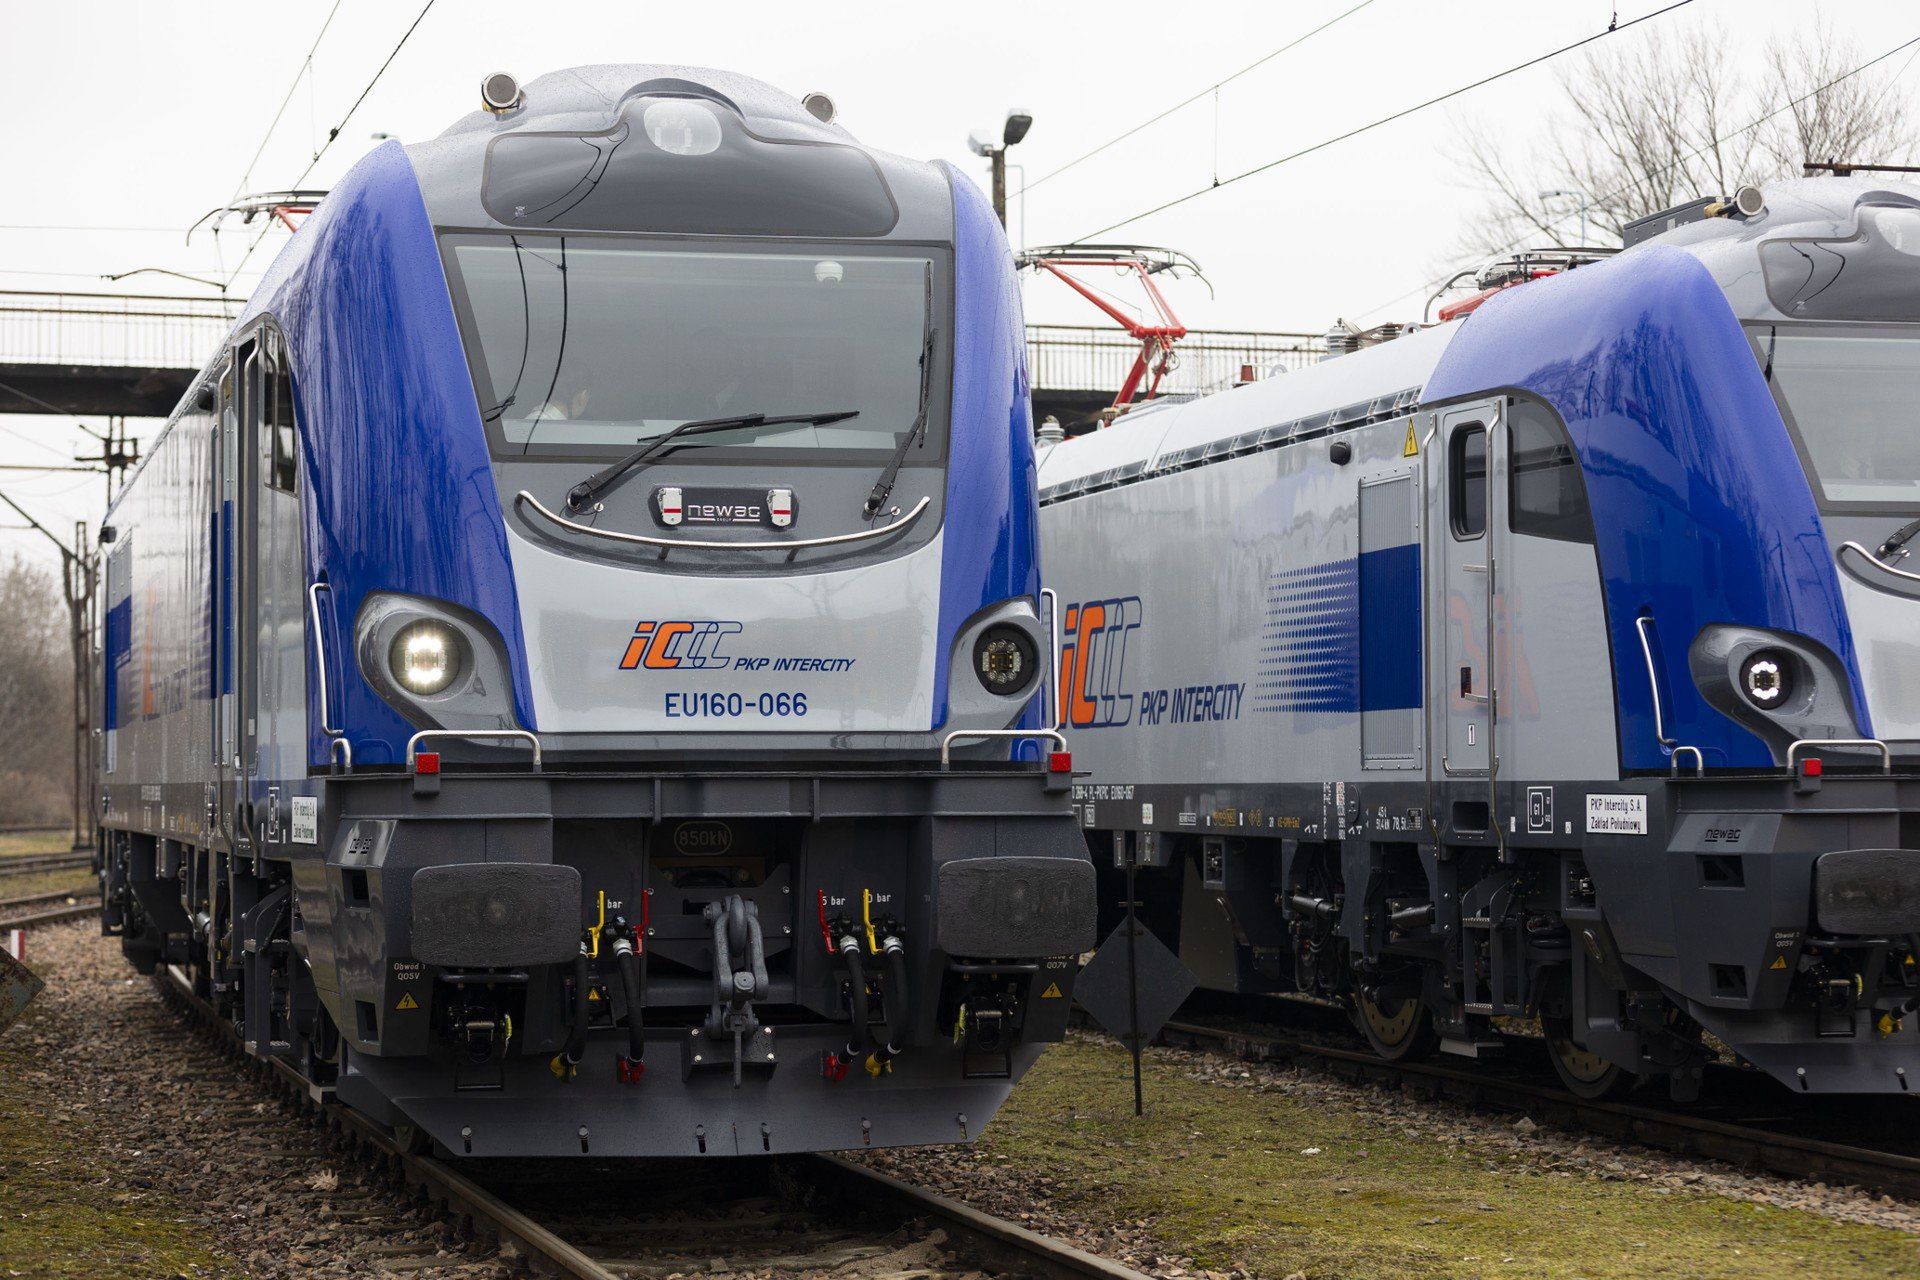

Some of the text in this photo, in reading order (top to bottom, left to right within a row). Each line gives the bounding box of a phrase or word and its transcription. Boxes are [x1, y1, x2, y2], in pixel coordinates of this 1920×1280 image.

[733, 657, 856, 672] PKP INTERCITY
[665, 692, 808, 717] EU160-066
[1139, 682, 1247, 726] PKP INTERCITY
[1591, 798, 1603, 811] PKP
[1604, 799, 1629, 814] Intercity
[607, 899, 623, 909] bar
[831, 896, 846, 906] bar
[877, 893, 892, 903] bar
